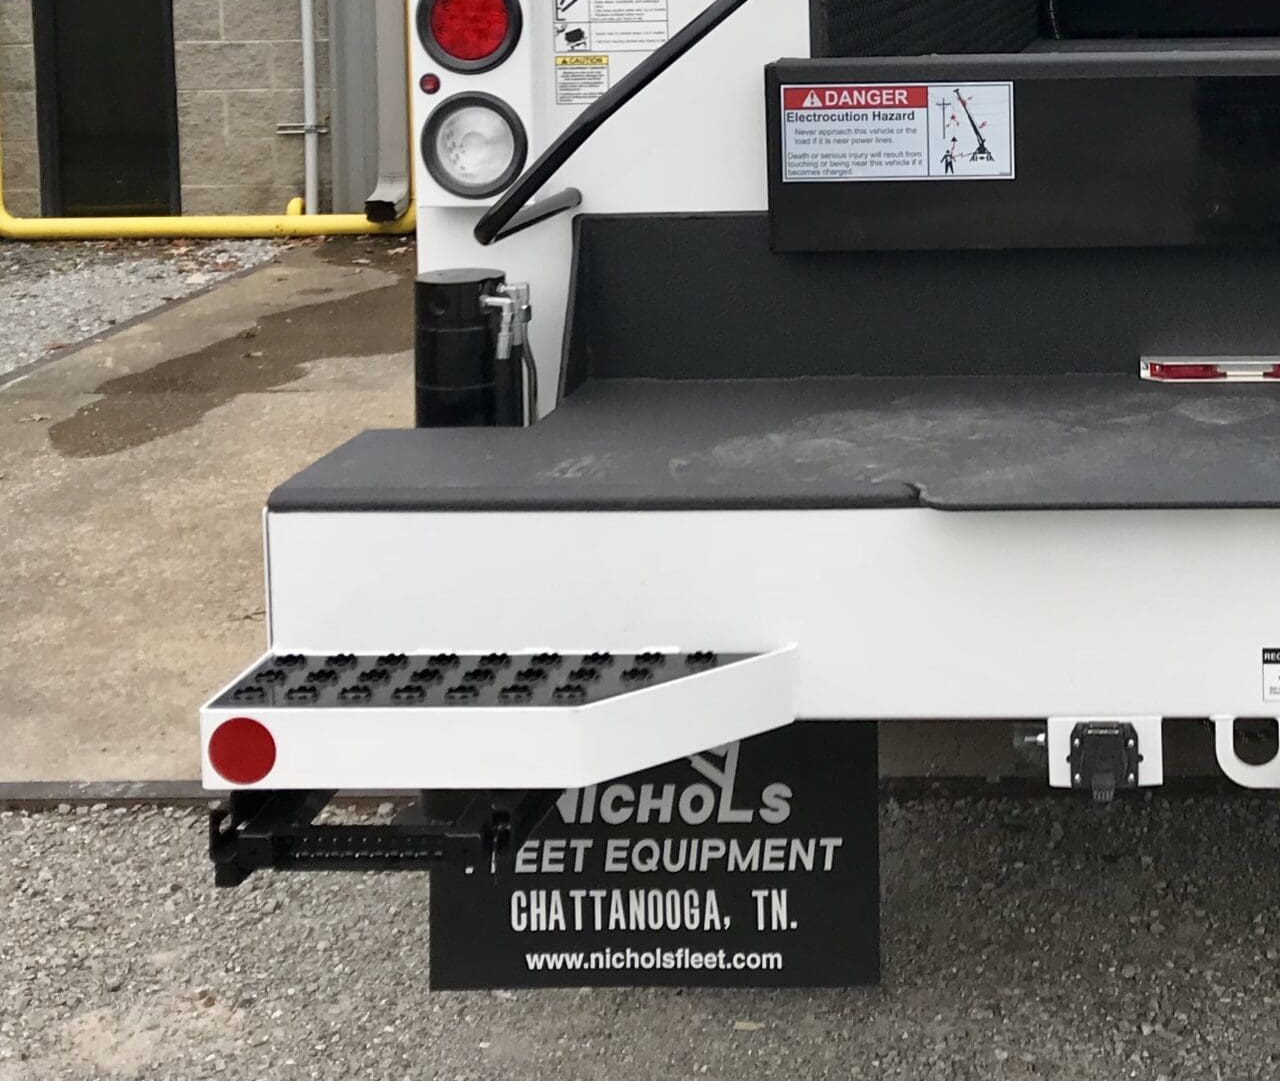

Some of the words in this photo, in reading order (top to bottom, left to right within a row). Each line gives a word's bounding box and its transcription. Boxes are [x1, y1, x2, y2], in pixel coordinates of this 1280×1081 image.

[825, 89, 908, 106] DANGER
[787, 112, 868, 122] Electrocution
[872, 111, 915, 121] Hazard
[818, 128, 852, 136] approach
[604, 837, 843, 873] EQUIPMENT
[511, 888, 731, 932] CHATTANOOGA,
[752, 888, 798, 930] TN.
[526, 947, 783, 970] www.nicholsfleet.com
